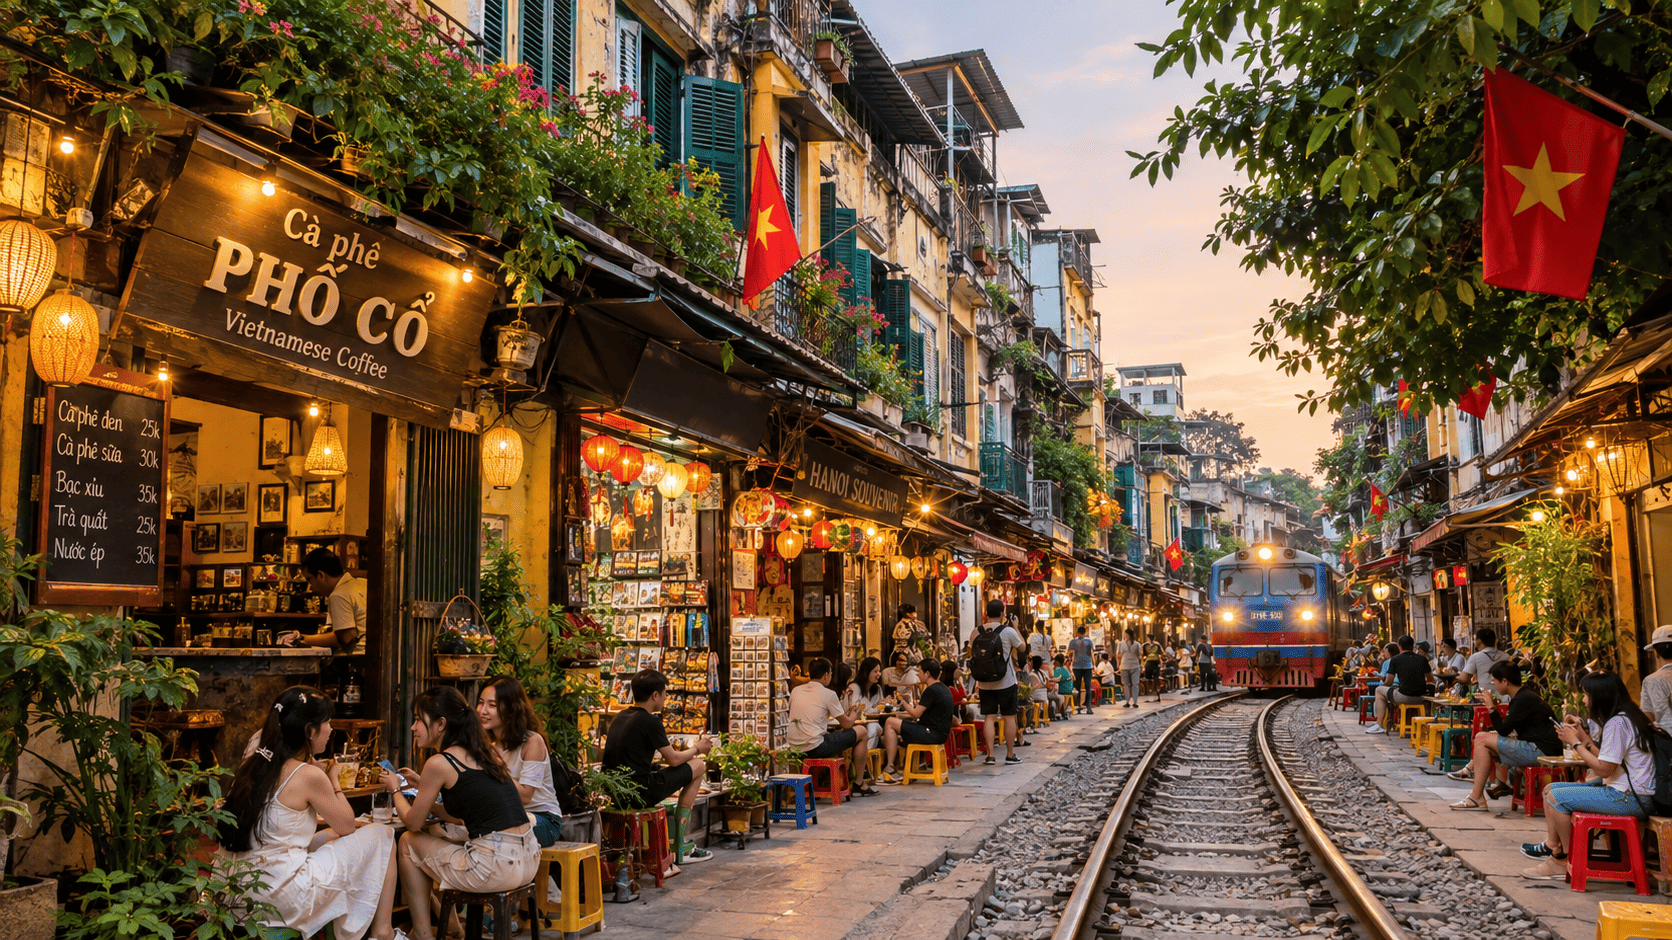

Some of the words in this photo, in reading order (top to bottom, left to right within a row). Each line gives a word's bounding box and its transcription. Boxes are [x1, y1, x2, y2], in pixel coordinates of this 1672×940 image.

[283, 208, 321, 248] Cà
[326, 232, 382, 270] phê
[203, 235, 349, 326] PHỐ
[356, 291, 436, 358] CỔ
[225, 308, 332, 362] Vietnamese
[336, 346, 388, 379] Coffee
[58, 399, 75, 423] Cà
[77, 405, 99, 432] phê
[140, 418, 160, 439] 25k
[57, 432, 74, 456] Cà
[76, 437, 98, 465] phê
[101, 443, 123, 463] sữa
[139, 448, 159, 469] 30k
[55, 470, 81, 498] Bạc
[137, 483, 158, 504] 35k
[809, 461, 850, 498] HANOI
[851, 478, 899, 514] SOUVENIR
[54, 504, 76, 527] Trà
[136, 515, 156, 535] 25k
[54, 537, 86, 560] Nước
[90, 542, 105, 569] ép
[135, 545, 156, 565] 35k
